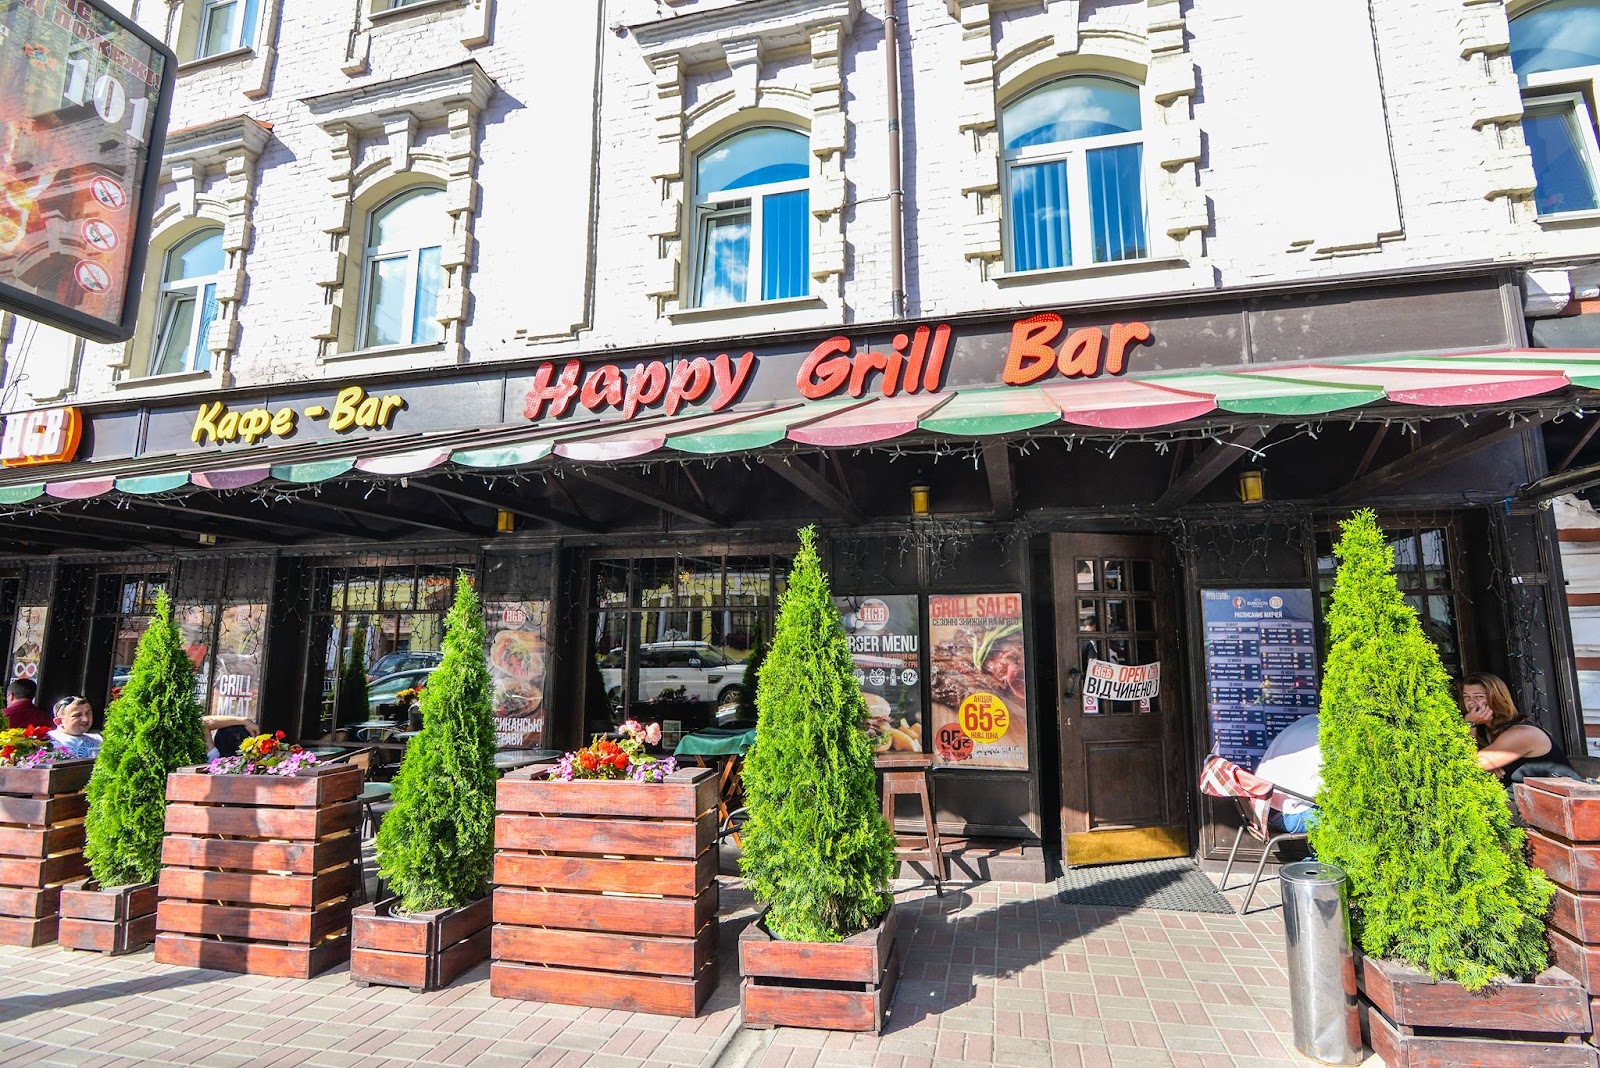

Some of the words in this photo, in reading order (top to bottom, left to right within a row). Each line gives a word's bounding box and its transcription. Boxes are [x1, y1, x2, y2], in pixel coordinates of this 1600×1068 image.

[64, 58, 149, 143] 101
[523, 351, 754, 420] Happy
[796, 322, 951, 399] Grill
[1002, 313, 1150, 386] Bar
[191, 401, 295, 443] Кафе
[328, 386, 403, 431] Bar
[863, 607, 885, 621] HGB
[932, 597, 972, 618] GRILL
[976, 596, 1018, 617] SALE!
[848, 635, 879, 652] RGER
[882, 635, 917, 652] MENU
[1119, 665, 1147, 682] OPEN
[220, 674, 253, 695] GRILL
[217, 696, 252, 716] MEAT
[493, 717, 543, 732] СИКАНСЬКІ
[496, 732, 523, 745] ТРАВИ
